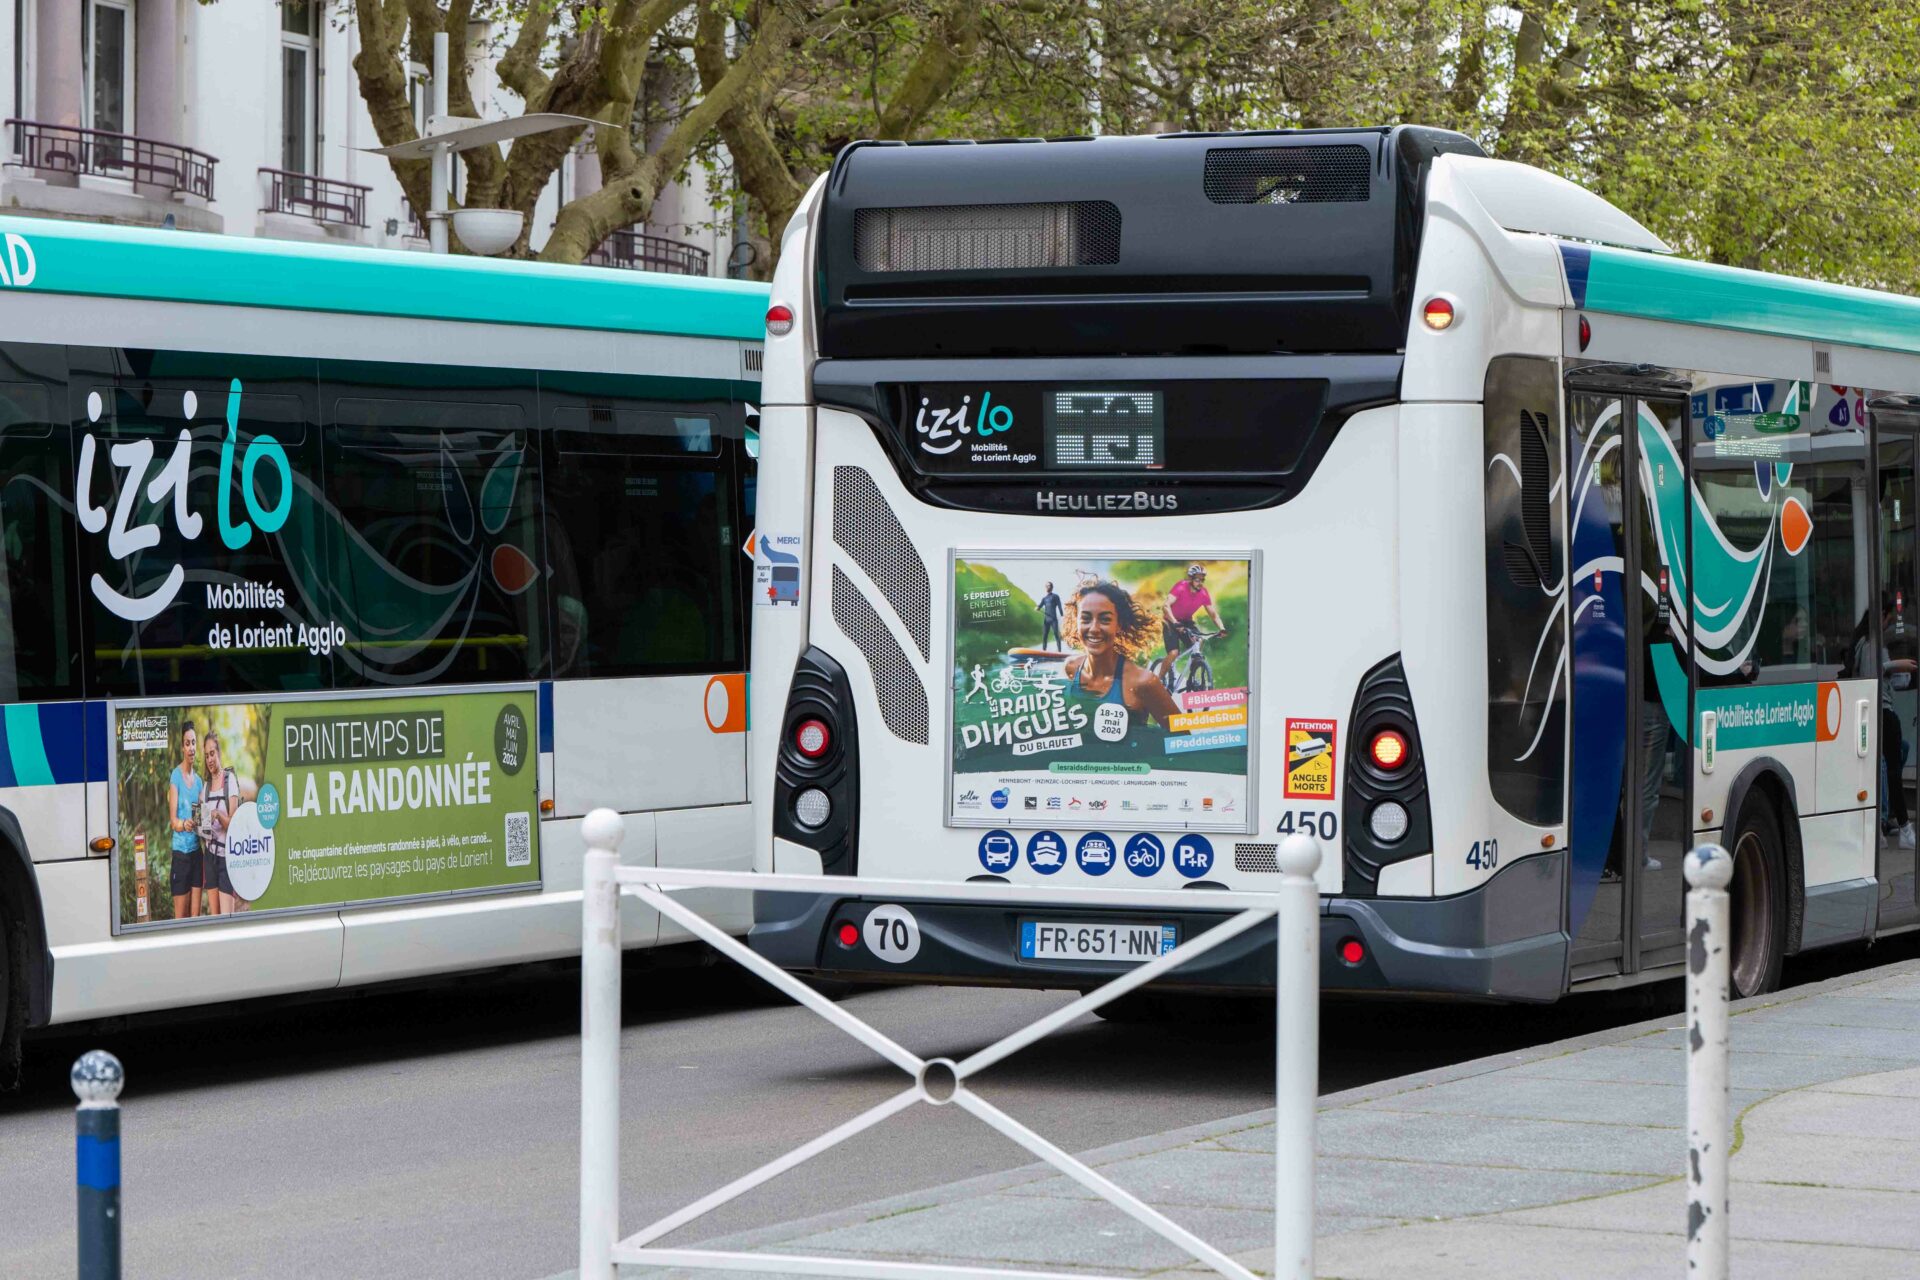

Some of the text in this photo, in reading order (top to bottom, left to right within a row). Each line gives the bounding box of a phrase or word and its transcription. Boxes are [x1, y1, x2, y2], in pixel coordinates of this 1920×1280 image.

[971, 443, 1008, 452] Mobilités
[971, 453, 1037, 464] de Lorient Agglo
[777, 536, 800, 545] MERCI
[206, 580, 285, 610] Mobilités
[963, 589, 1010, 601] 5 ÉPREUVES
[970, 598, 1007, 609] EN PLEINE
[972, 609, 1002, 619] NATURE
[209, 621, 346, 656] de Lorient Agglo
[1000, 690, 1066, 717] RAIDS
[1187, 691, 1244, 706] #Bike&Run
[990, 698, 999, 718] LES
[1716, 699, 1814, 729] Mobilités de Lorient Agglo
[122, 717, 148, 729] Lorient
[503, 713, 520, 729] AVRIL
[960, 703, 1088, 749] DINGUES
[1104, 718, 1120, 726] mai
[1173, 712, 1243, 728] #Paddle&Run
[1290, 722, 1333, 731] ATTENTION
[505, 726, 517, 740] MAI
[1101, 726, 1121, 735] 2024
[286, 717, 443, 762] PRINTEMPS DE
[503, 740, 518, 754] JUIN
[1019, 737, 1074, 753] DU BLAVET
[1169, 734, 1241, 749] #Paddle&Bike
[502, 752, 518, 767] 2024
[1057, 764, 1143, 774] lesraidsdingues-blavet.fr
[286, 752, 492, 818] LA RANDONNÉE
[1292, 774, 1328, 783] ANGLES
[1294, 783, 1326, 792] MORTS
[1276, 810, 1338, 841] 450
[288, 848, 301, 860] Une
[302, 844, 342, 861] cinquantaine
[387, 837, 420, 852] randonnée
[421, 837, 425, 849] à
[426, 836, 441, 851] pied,
[442, 835, 446, 847] à
[446, 834, 460, 848] vélo,
[461, 835, 469, 845] en
[1466, 838, 1498, 870] 450
[1179, 845, 1208, 868] P+R
[288, 863, 353, 885] [Re]découvrez
[354, 861, 368, 878] les
[370, 860, 411, 880] paysages
[412, 856, 424, 872] du
[426, 857, 446, 875] pays
[447, 852, 458, 869] de
[460, 850, 489, 867] Lorient
[874, 918, 909, 951] 70
[1040, 927, 1158, 955] FR-651-NN
[1026, 941, 1031, 949] F
